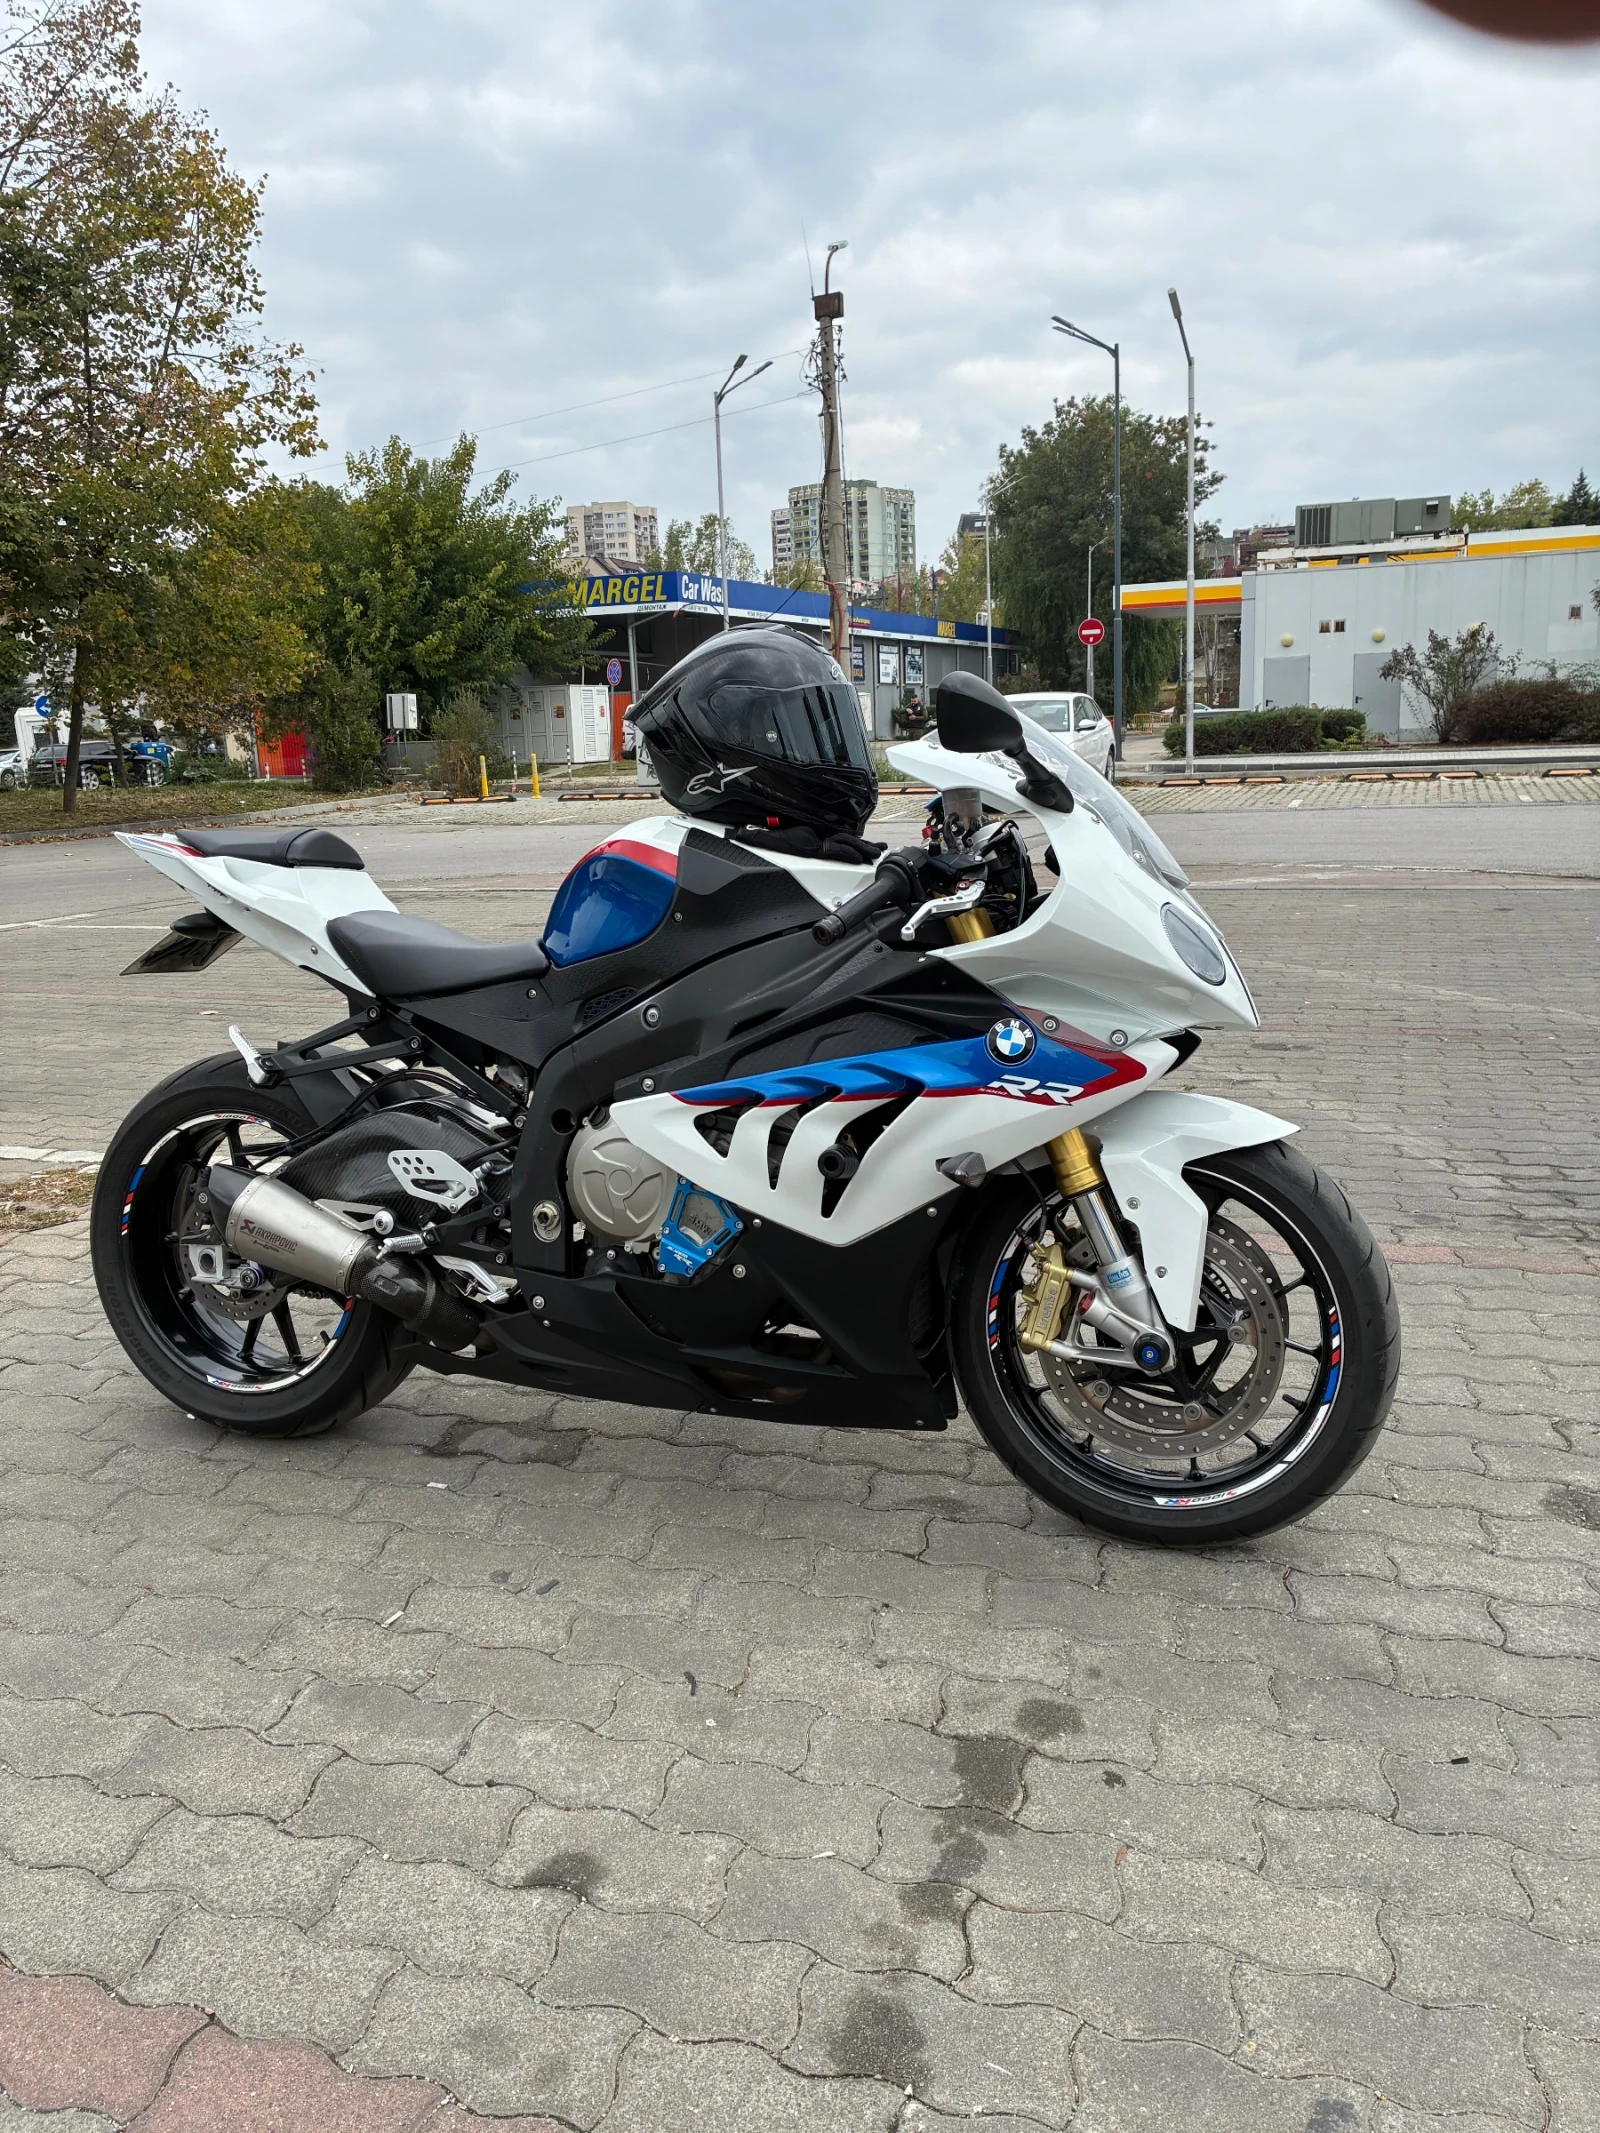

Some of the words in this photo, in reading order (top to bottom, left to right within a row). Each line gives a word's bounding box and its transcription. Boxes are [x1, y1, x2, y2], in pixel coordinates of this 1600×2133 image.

[566, 575, 667, 606] MARGEL
[681, 574, 700, 600] Car
[701, 577, 724, 604] Was
[994, 1018, 1033, 1040] BMW
[987, 1073, 1085, 1105] RR
